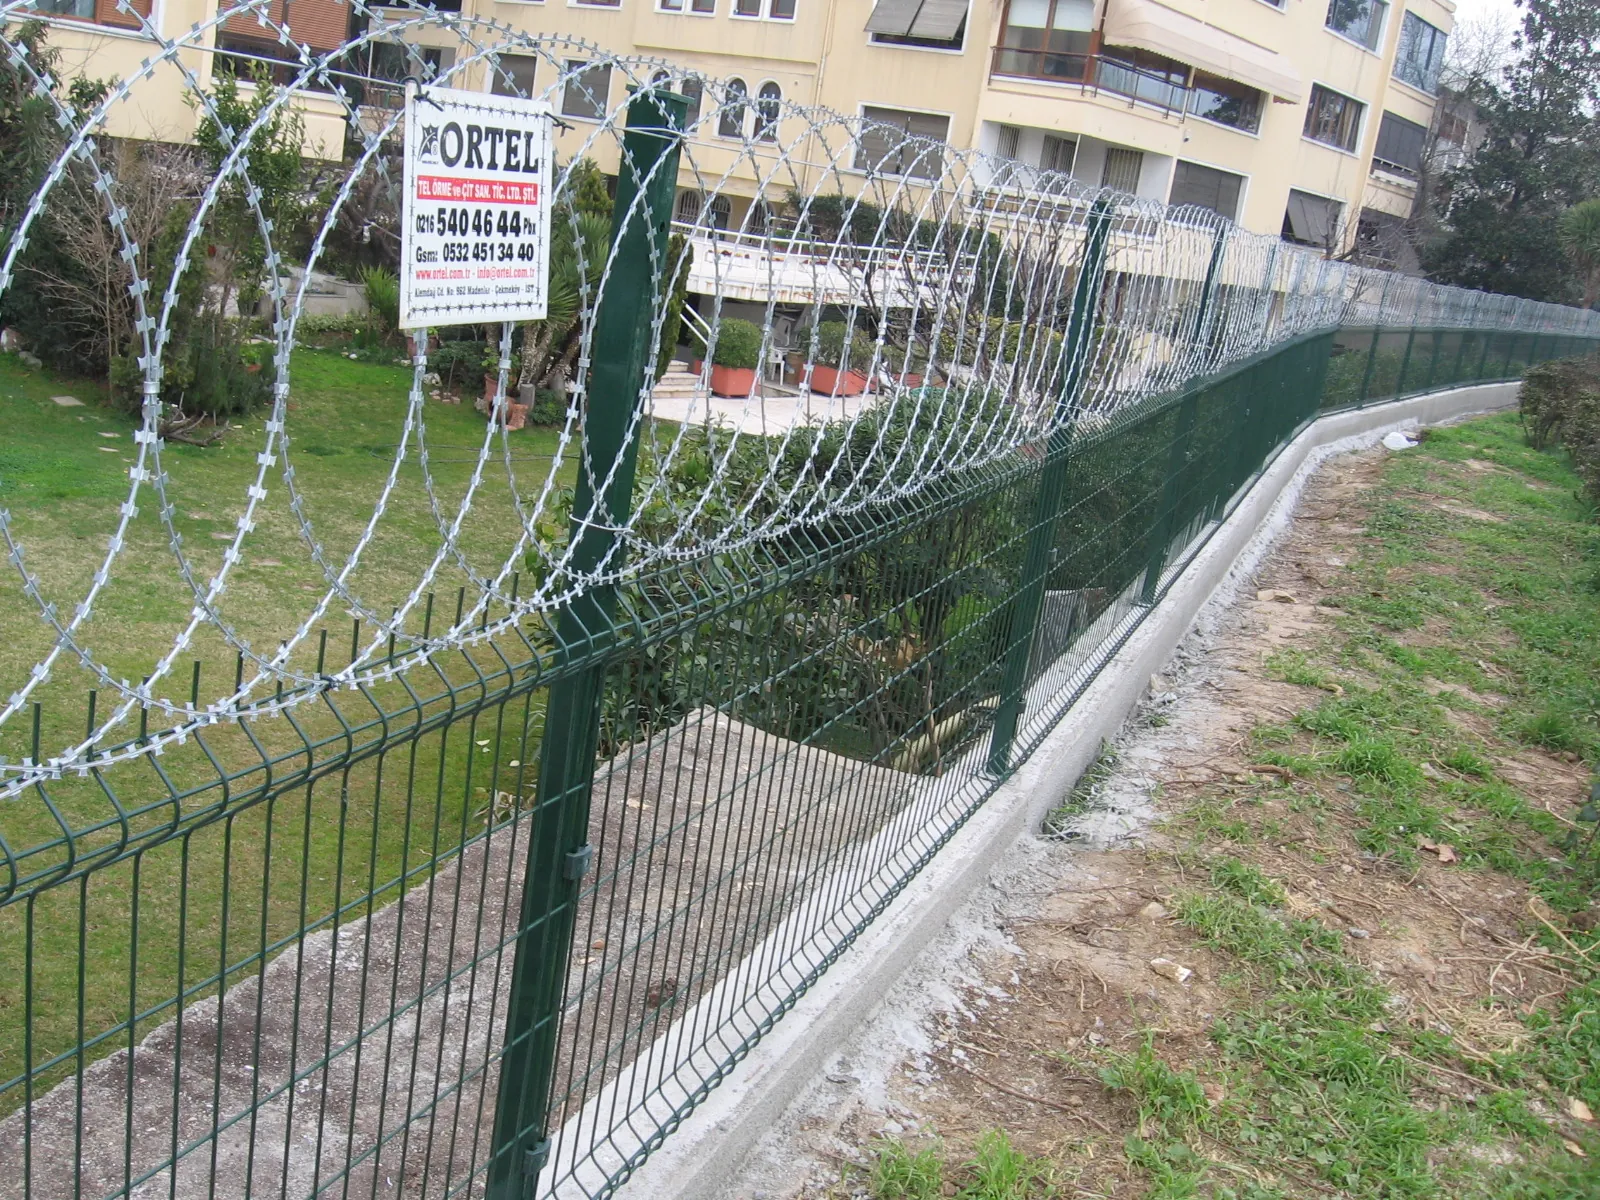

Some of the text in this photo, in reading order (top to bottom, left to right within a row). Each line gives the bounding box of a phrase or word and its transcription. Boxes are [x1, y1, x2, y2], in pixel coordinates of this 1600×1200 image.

[440, 121, 539, 174] ORTEL
[418, 180, 431, 196] TEL
[432, 178, 452, 197] ÖRME
[452, 185, 461, 197] ve
[461, 180, 474, 201] ÇİT
[474, 183, 491, 199] SAN.
[492, 182, 506, 200] TİC.
[506, 185, 521, 200] LTD.
[416, 207, 536, 237] 0216 540 46 44 Pbx
[416, 243, 534, 263] Gsm: 0532 451 34 40
[416, 267, 471, 280] www.ortel.com.tr
[477, 266, 535, 281] info@ortel.com.tr
